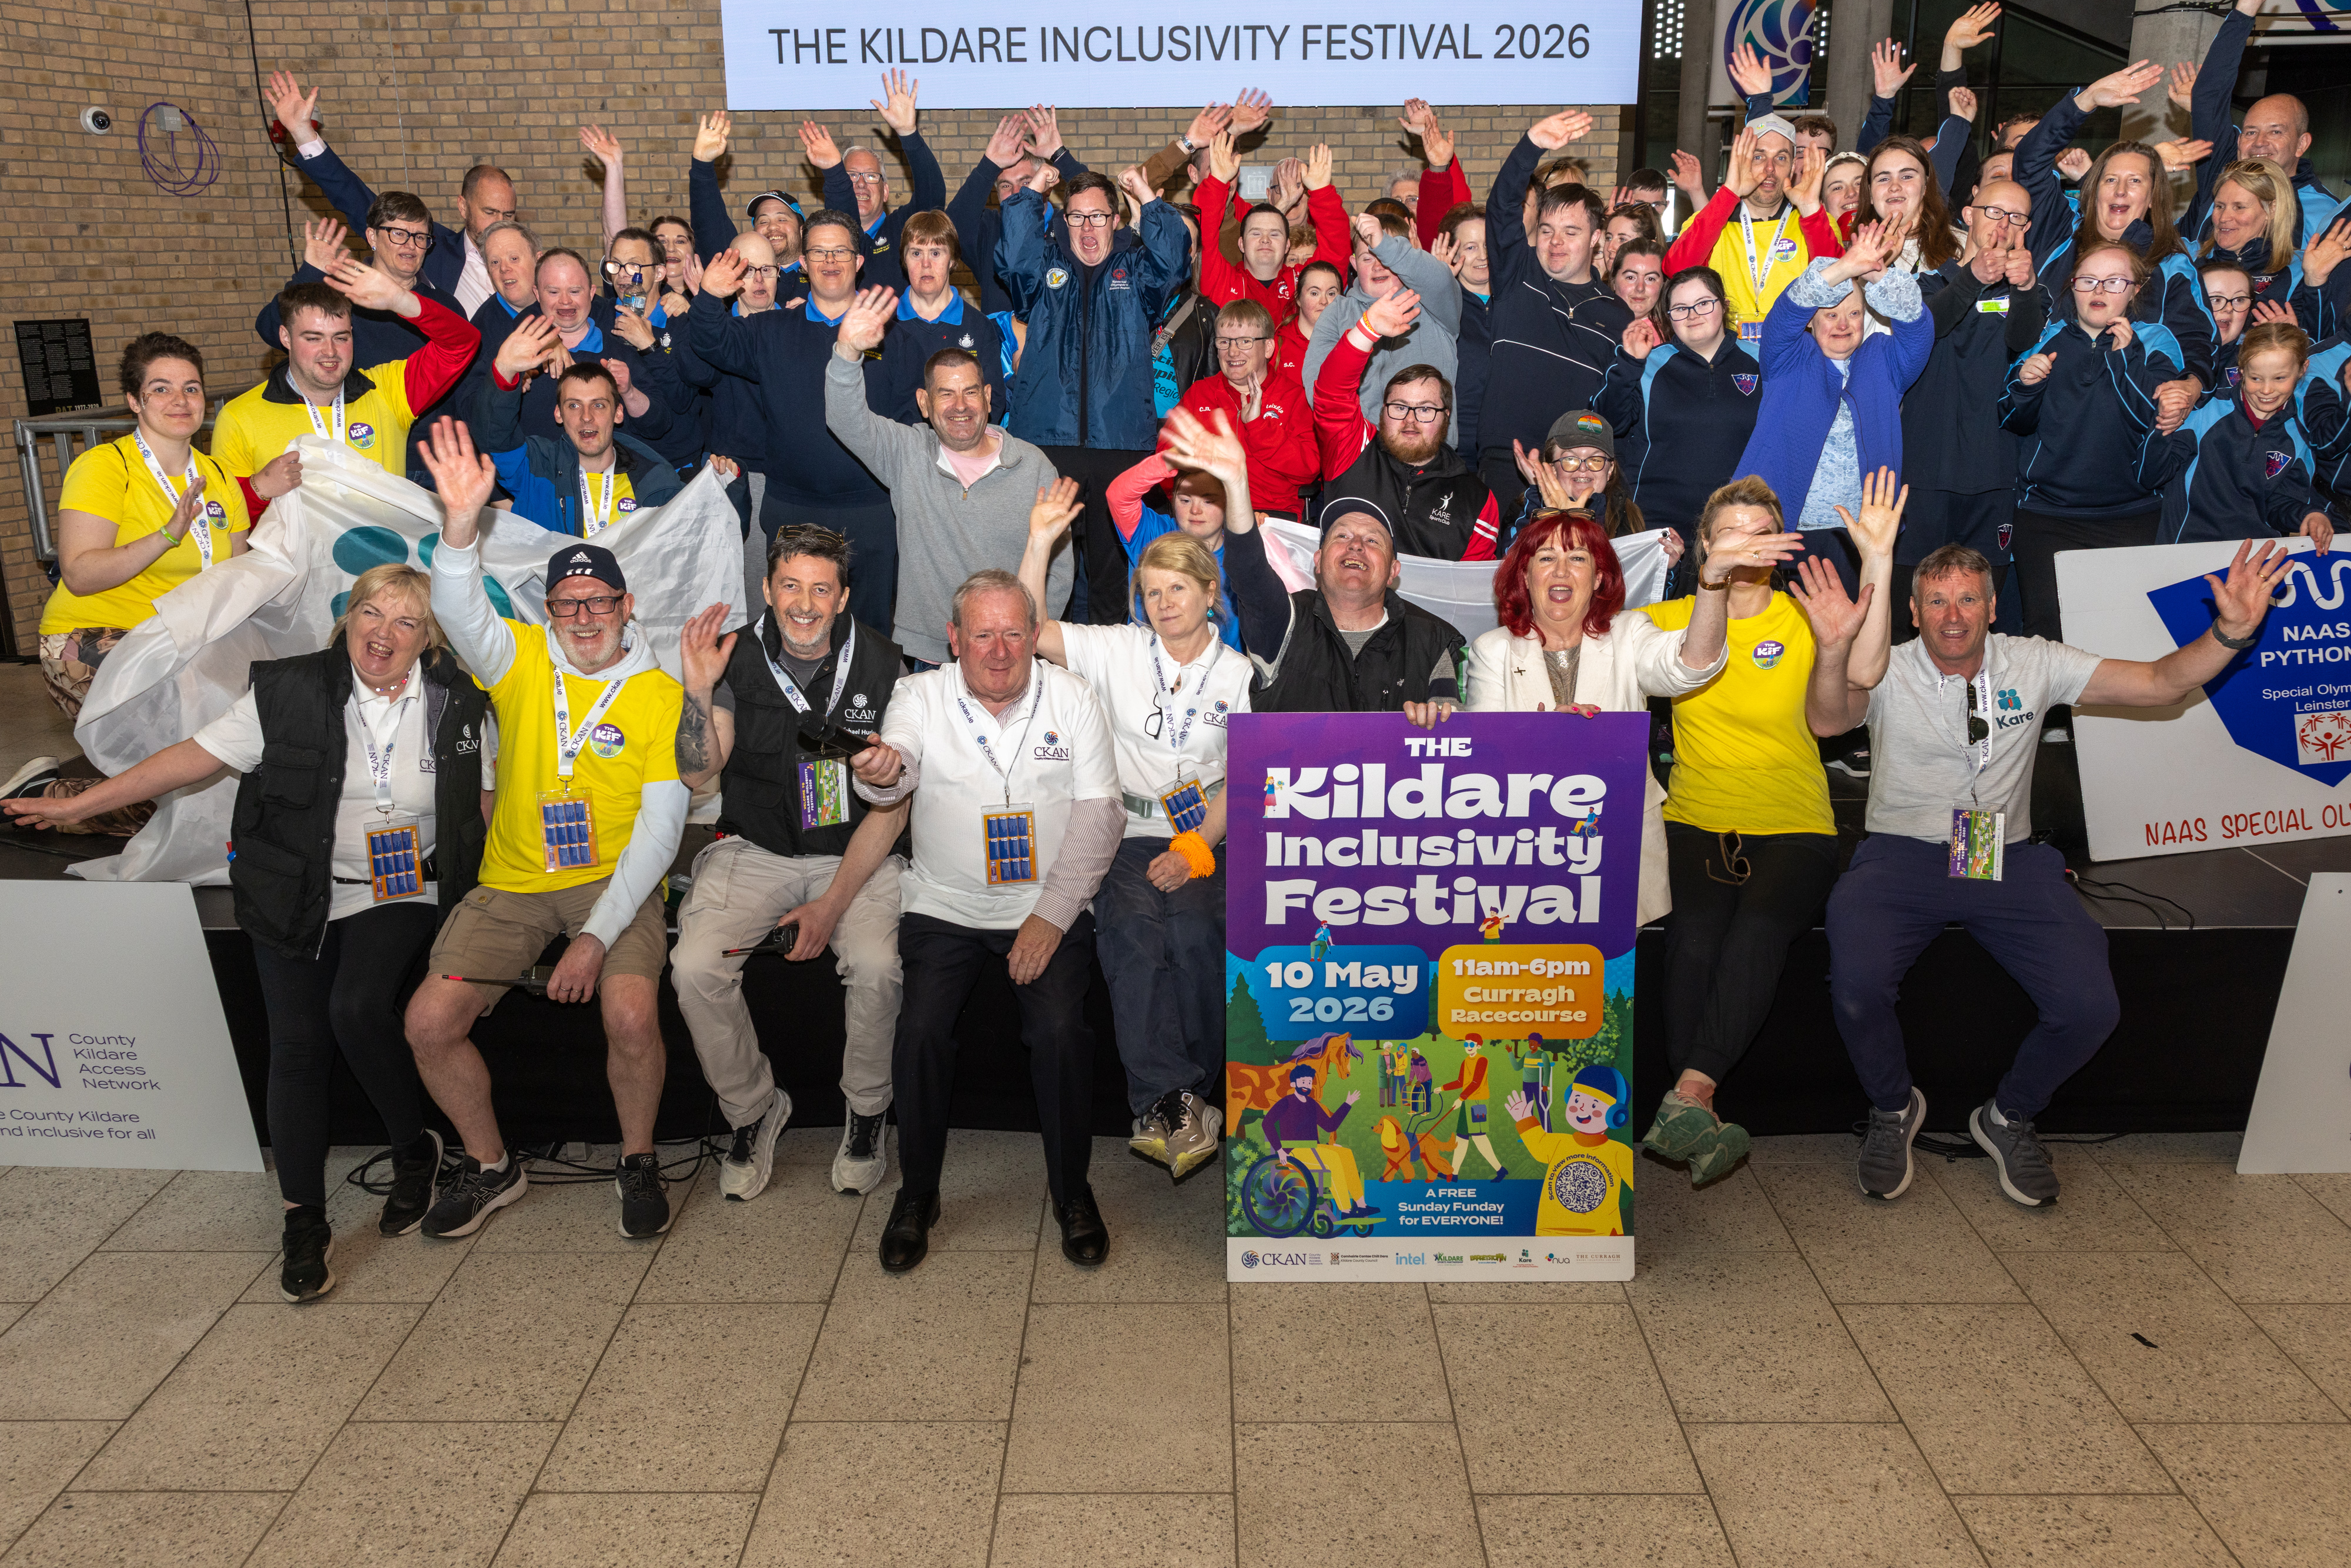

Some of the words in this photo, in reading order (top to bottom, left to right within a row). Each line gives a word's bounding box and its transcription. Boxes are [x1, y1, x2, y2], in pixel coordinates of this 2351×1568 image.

[768, 28, 848, 64] THE
[860, 26, 1027, 63] KILDARE
[1040, 25, 1291, 62] INCLUSIVITY
[1302, 24, 1482, 61] FESTIVAL
[1493, 24, 1590, 59] 2026
[1743, 213, 1751, 244] www.ckan.ie
[1773, 217, 1787, 246] www.ckan.ie
[1761, 261, 1771, 281] CKAN
[350, 425, 369, 437] KiF
[580, 470, 589, 504] www.ckan.ie
[207, 507, 223, 515] KiF
[1432, 508, 1451, 520] KARE
[192, 528, 206, 550] CKAN
[2282, 622, 2351, 642] NAAS
[1757, 646, 1781, 656] KiF
[1154, 657, 1167, 692] www.ckan.ie
[600, 679, 623, 708] www.ckan
[831, 684, 842, 708] CKAN
[1031, 680, 1043, 719] www.ckan.ie
[1979, 669, 1988, 712] www.ckan.ie
[2262, 685, 2313, 700] Special
[2317, 684, 2351, 697] Olym
[845, 709, 876, 719] CKAN
[2296, 700, 2350, 712] Leinster
[1166, 713, 1176, 737] CKAN
[1204, 712, 1227, 725] CKA
[1995, 711, 2034, 729] Kare
[559, 722, 567, 747] CKAN
[570, 727, 589, 750] CKAN
[595, 729, 621, 742] KiF
[1179, 718, 1192, 741] CKAN
[456, 739, 480, 751] CKN
[1034, 746, 1069, 758] CKAN
[1404, 737, 1472, 758] THE
[420, 759, 436, 770] CK
[983, 745, 998, 766] CKAN
[381, 753, 390, 779] CKAN
[1265, 763, 1607, 820] Kildare
[2145, 817, 2208, 846] NAAS
[2221, 808, 2313, 839] SPECIAL
[1265, 826, 1603, 875] Inclusivity
[1265, 874, 1602, 926] Festival
[1265, 961, 1314, 989] 10
[1324, 961, 1418, 994] May
[1452, 958, 1590, 980] 11am-6pm
[1463, 985, 1575, 1006] Curragh
[1288, 996, 1394, 1022] 2026
[1450, 1007, 1587, 1023] Racecourse
[69, 1033, 136, 1048] County
[73, 1048, 138, 1060] Kildare
[79, 1063, 146, 1076] Access
[82, 1078, 161, 1090] Network
[10, 1109, 74, 1123] County
[78, 1111, 140, 1123] Kildare
[0, 1126, 23, 1137] nd
[27, 1125, 104, 1138] inclusive
[107, 1127, 132, 1139] for
[137, 1128, 156, 1140] all
[1548, 1172, 1555, 1181] to
[1552, 1158, 1566, 1173] view
[1566, 1153, 1586, 1161] more
[1586, 1153, 1615, 1187] information
[1425, 1188, 1436, 1198] A
[1438, 1188, 1476, 1198] FREE
[1398, 1202, 1451, 1214] Sunday
[1453, 1202, 1505, 1214] Funday
[1399, 1215, 1420, 1225] for
[1422, 1215, 1503, 1225] EVERYONE!
[1262, 1253, 1307, 1265] CKAN
[1395, 1252, 1425, 1265] intel
[1438, 1252, 1463, 1261] KILDARE
